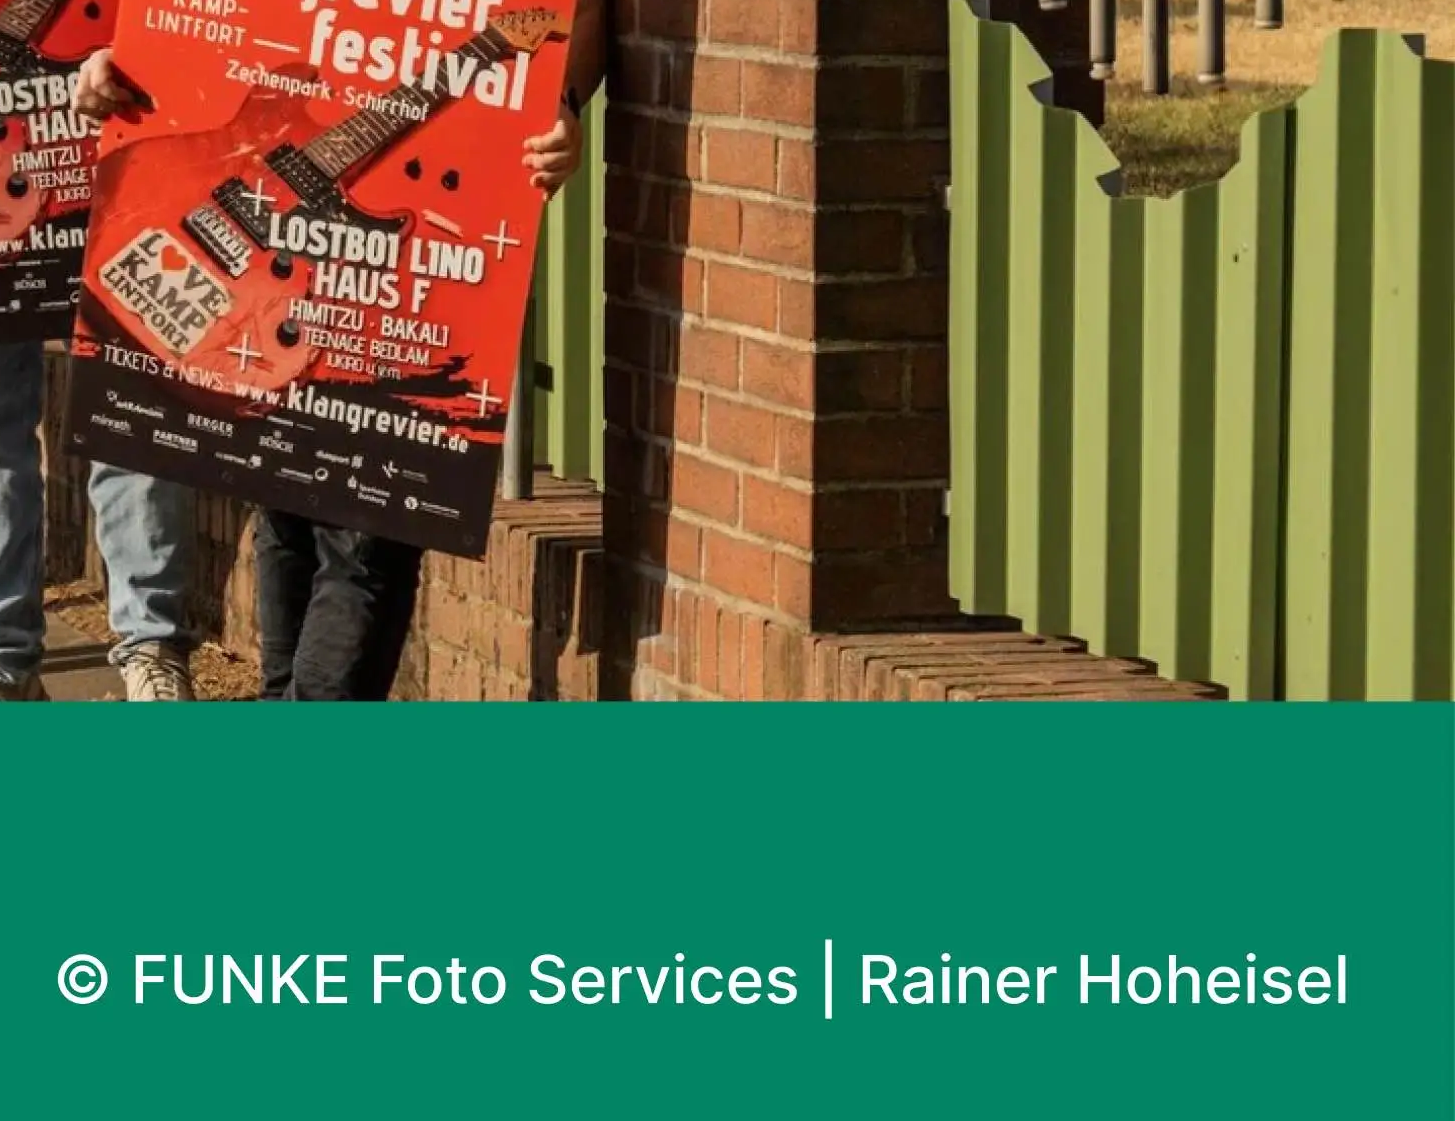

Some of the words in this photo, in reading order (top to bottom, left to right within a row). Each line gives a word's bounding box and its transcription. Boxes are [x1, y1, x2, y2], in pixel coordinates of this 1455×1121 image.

[146, 7, 247, 48] LINTFORT
[308, 7, 530, 112] festival
[225, 58, 333, 101] Zechenpark
[344, 84, 429, 122] Schirrhof
[117, 250, 207, 330] KAMP
[315, 260, 401, 310] HAUS
[411, 278, 432, 314] F
[304, 326, 367, 354] TEENAGE
[235, 380, 469, 454] www.klangrevier.de
